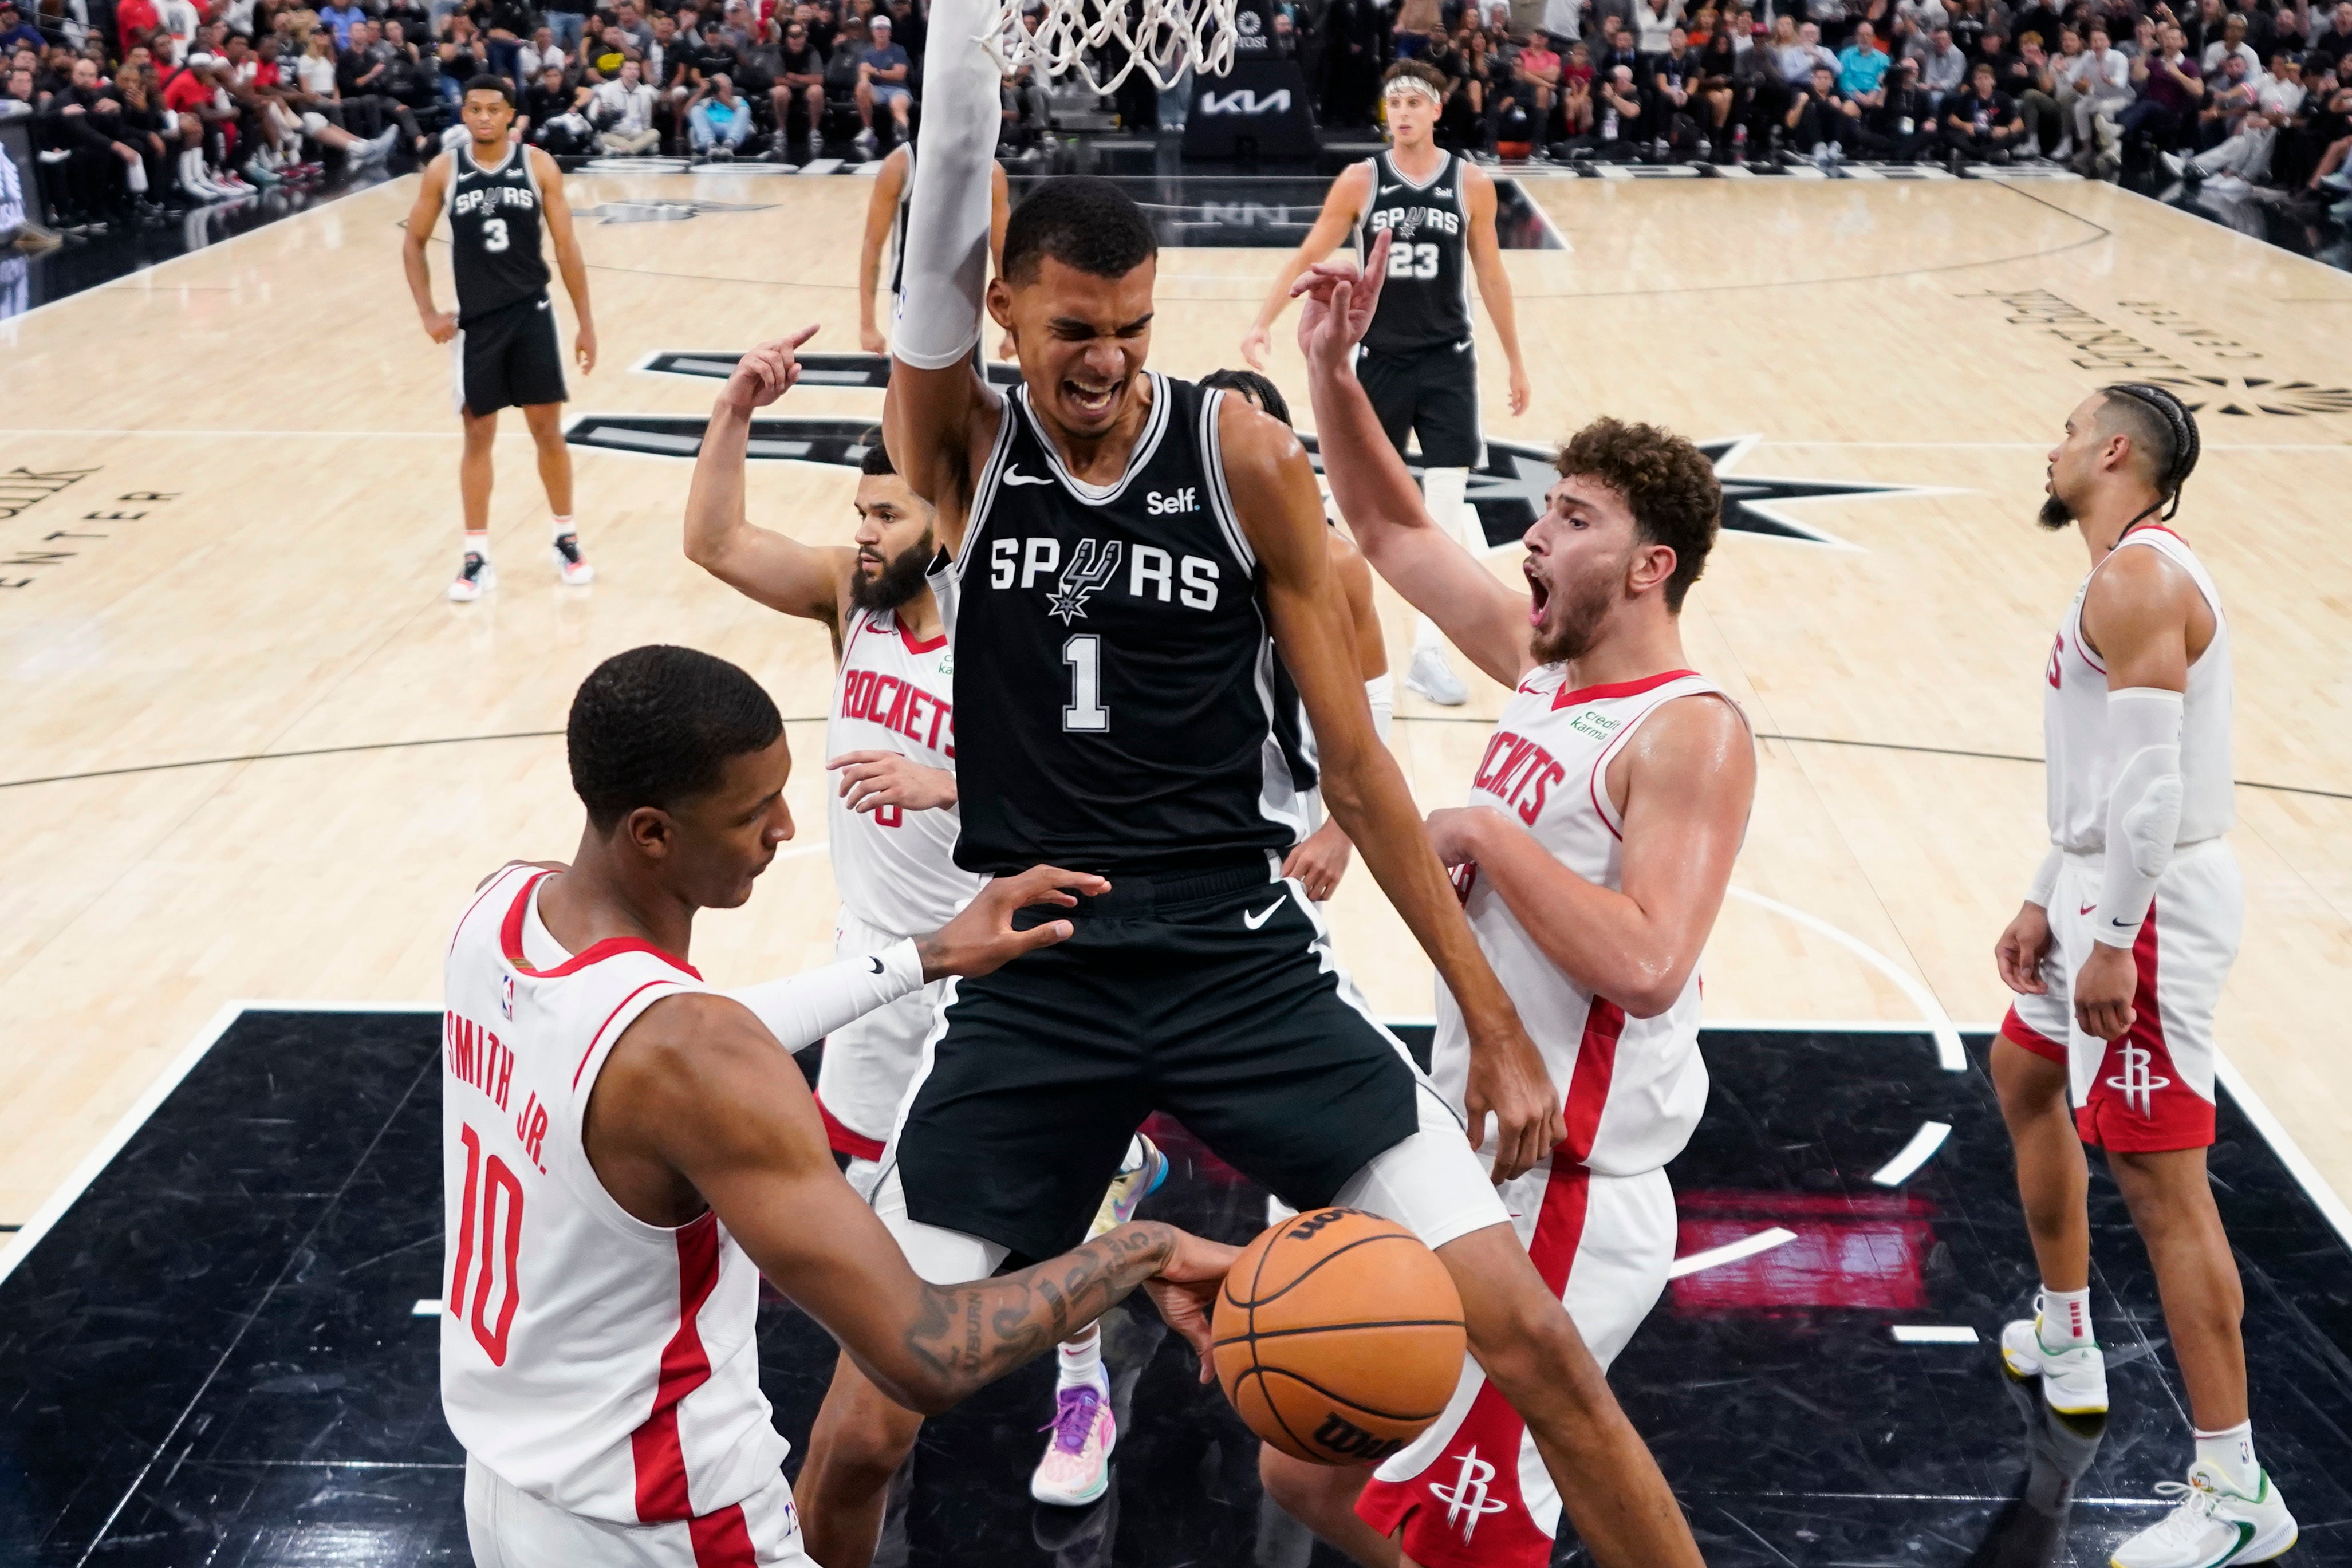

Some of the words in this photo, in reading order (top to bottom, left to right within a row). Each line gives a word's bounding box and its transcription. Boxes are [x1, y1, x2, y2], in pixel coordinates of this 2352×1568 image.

[1201, 89, 1291, 115] KIA
[455, 186, 534, 215] SPURS
[483, 218, 509, 251] 3
[1372, 206, 1460, 240] SPURS
[1388, 241, 1440, 279] 23
[991, 538, 1220, 624] SPURS
[1062, 633, 1110, 733] 1
[1571, 716, 1608, 741] karma
[1585, 710, 1621, 731] credit
[446, 1009, 514, 1114] SMITH
[517, 1088, 548, 1176] JR.
[449, 1121, 525, 1368] 10
